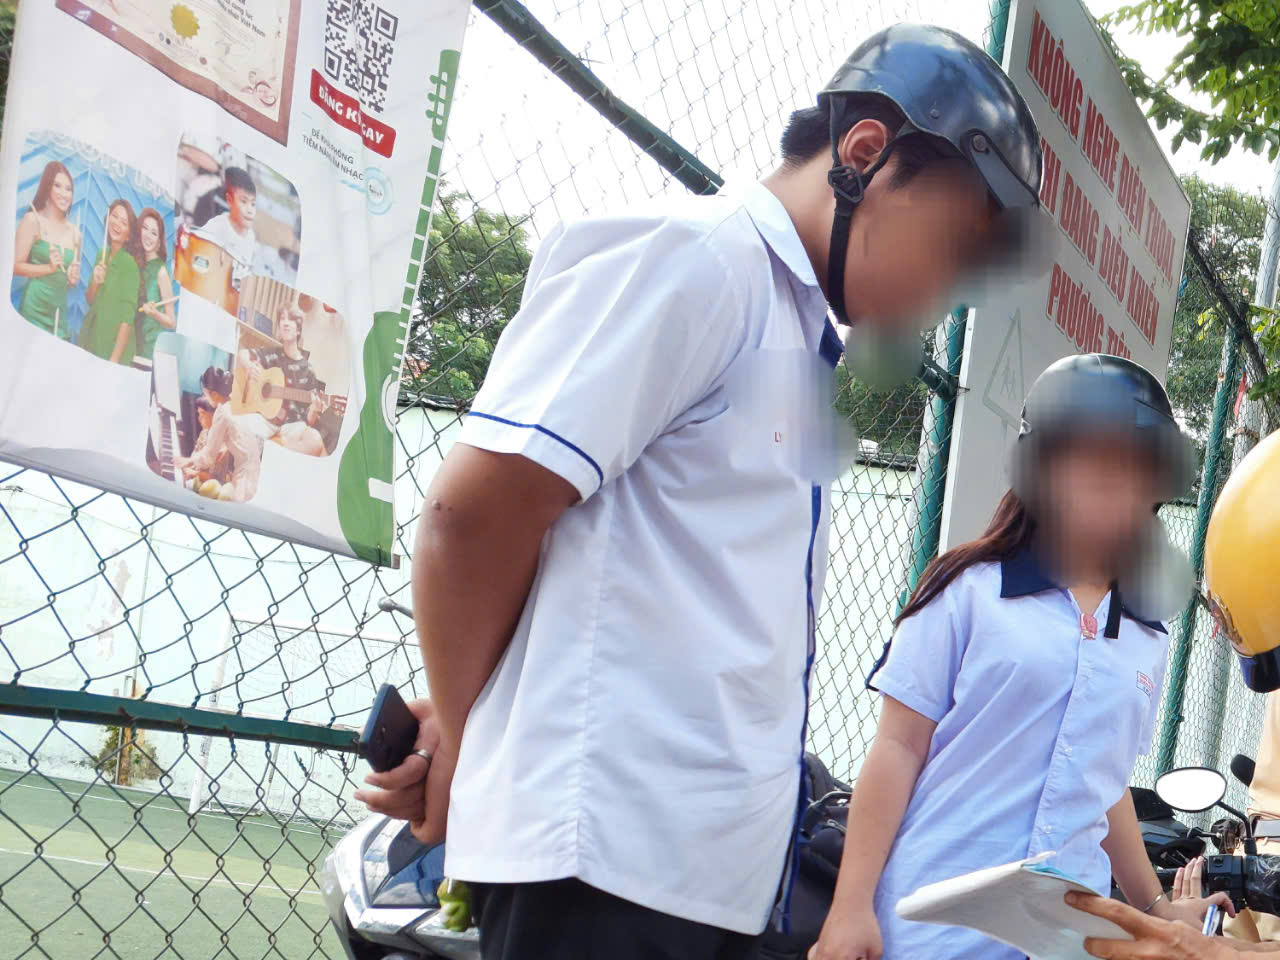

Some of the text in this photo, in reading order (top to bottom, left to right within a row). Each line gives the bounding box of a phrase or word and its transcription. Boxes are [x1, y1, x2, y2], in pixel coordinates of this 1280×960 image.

[340, 163, 365, 181] NHẠC
[1028, 9, 1083, 141] KHÔNG
[1082, 97, 1120, 192] NGHE
[1145, 197, 1176, 288] THOẠI
[1047, 262, 1105, 354] PHƯƠNG
[1126, 264, 1160, 346] KHIỂN
